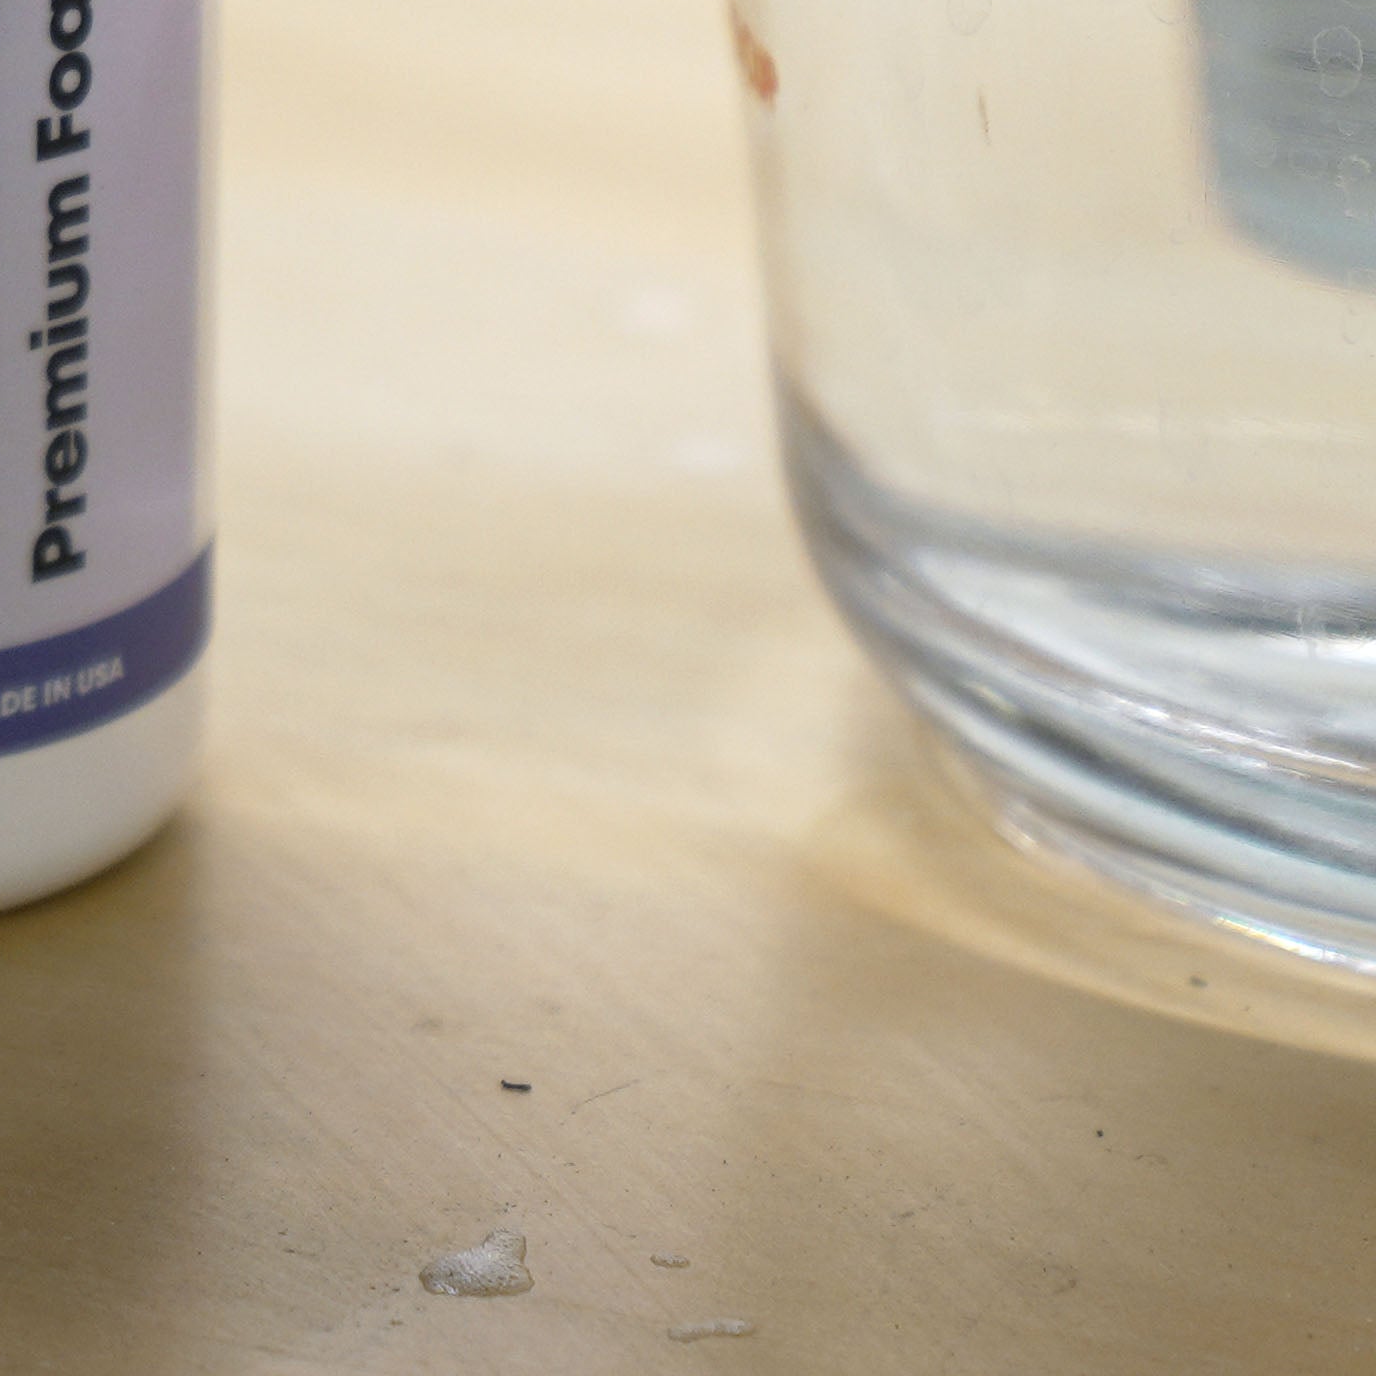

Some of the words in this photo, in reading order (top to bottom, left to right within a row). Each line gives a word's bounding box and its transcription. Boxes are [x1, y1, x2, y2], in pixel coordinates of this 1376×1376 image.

[30, 172, 92, 585] Premium
[43, 674, 72, 707] IN
[76, 655, 126, 696] USA
